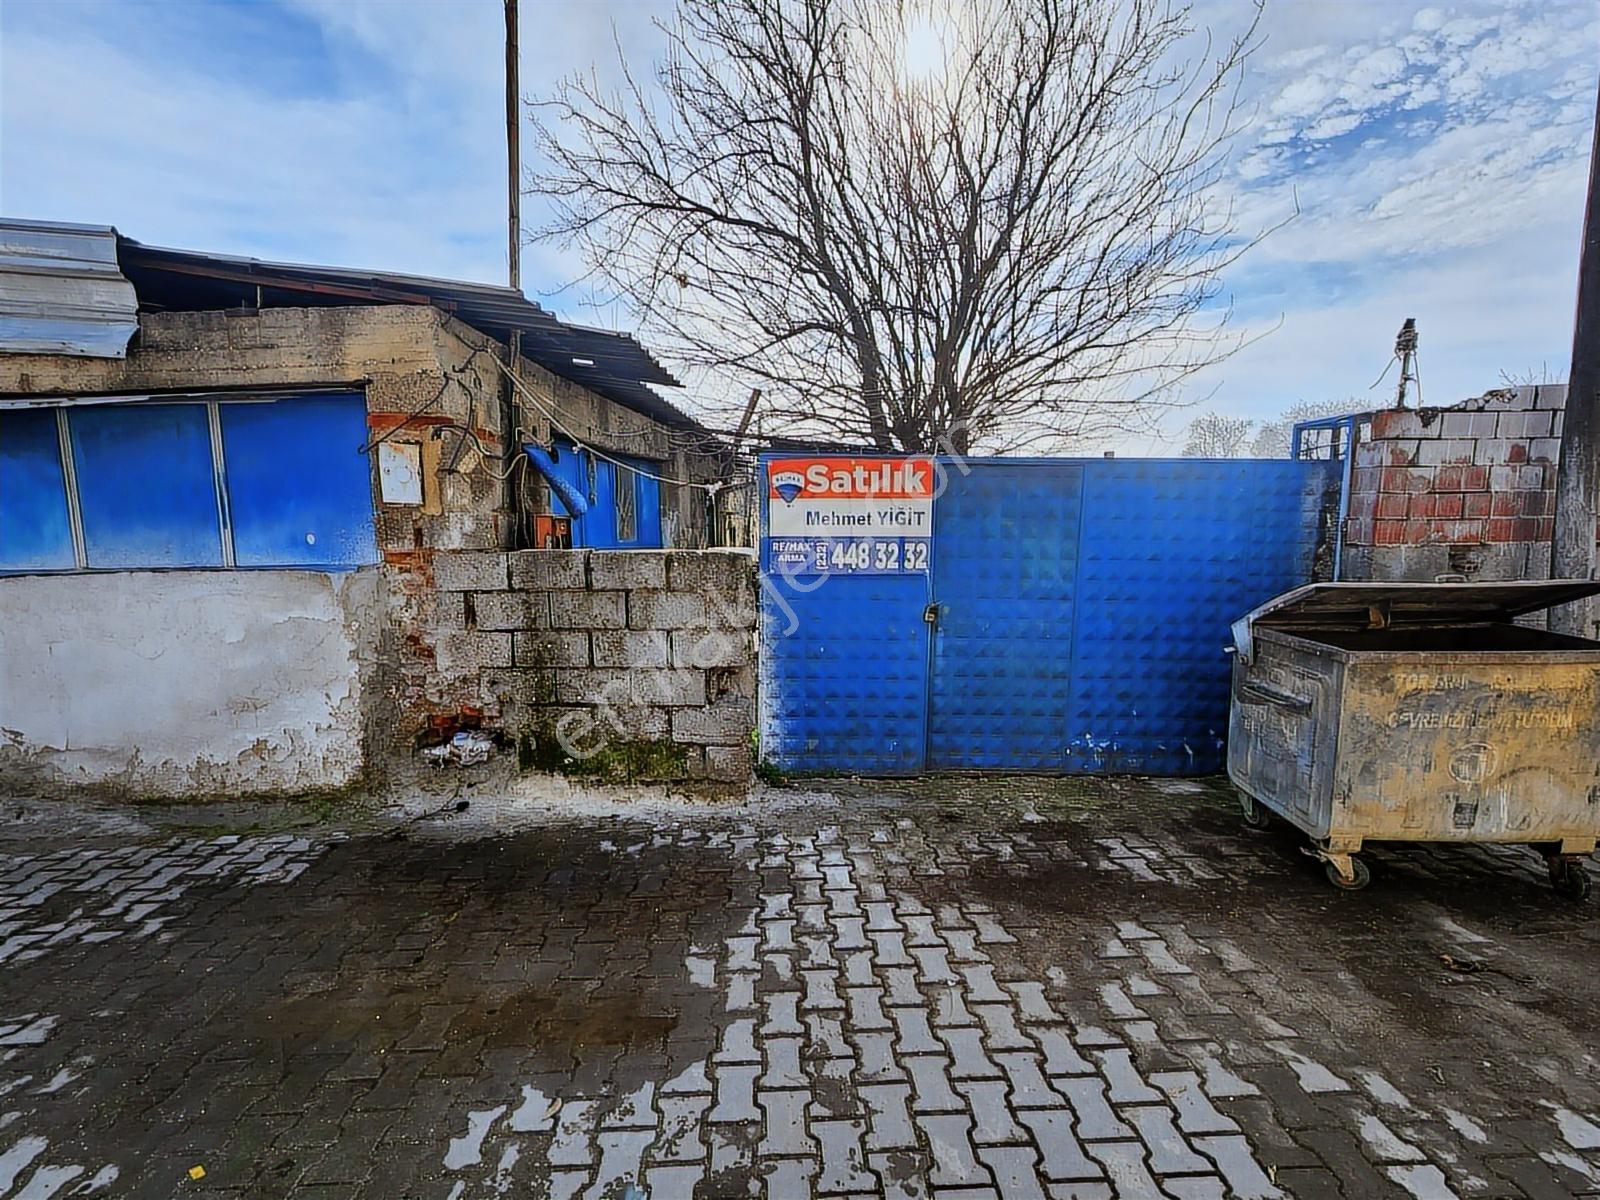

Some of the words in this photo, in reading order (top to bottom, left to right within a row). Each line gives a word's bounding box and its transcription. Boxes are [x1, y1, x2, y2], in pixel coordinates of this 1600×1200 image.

[806, 463, 927, 494] Satılık
[806, 511, 872, 526] Mehmet
[877, 507, 926, 526] YİĞİT
[831, 542, 871, 570] 448
[875, 542, 899, 570] 32
[904, 542, 928, 570] 32
